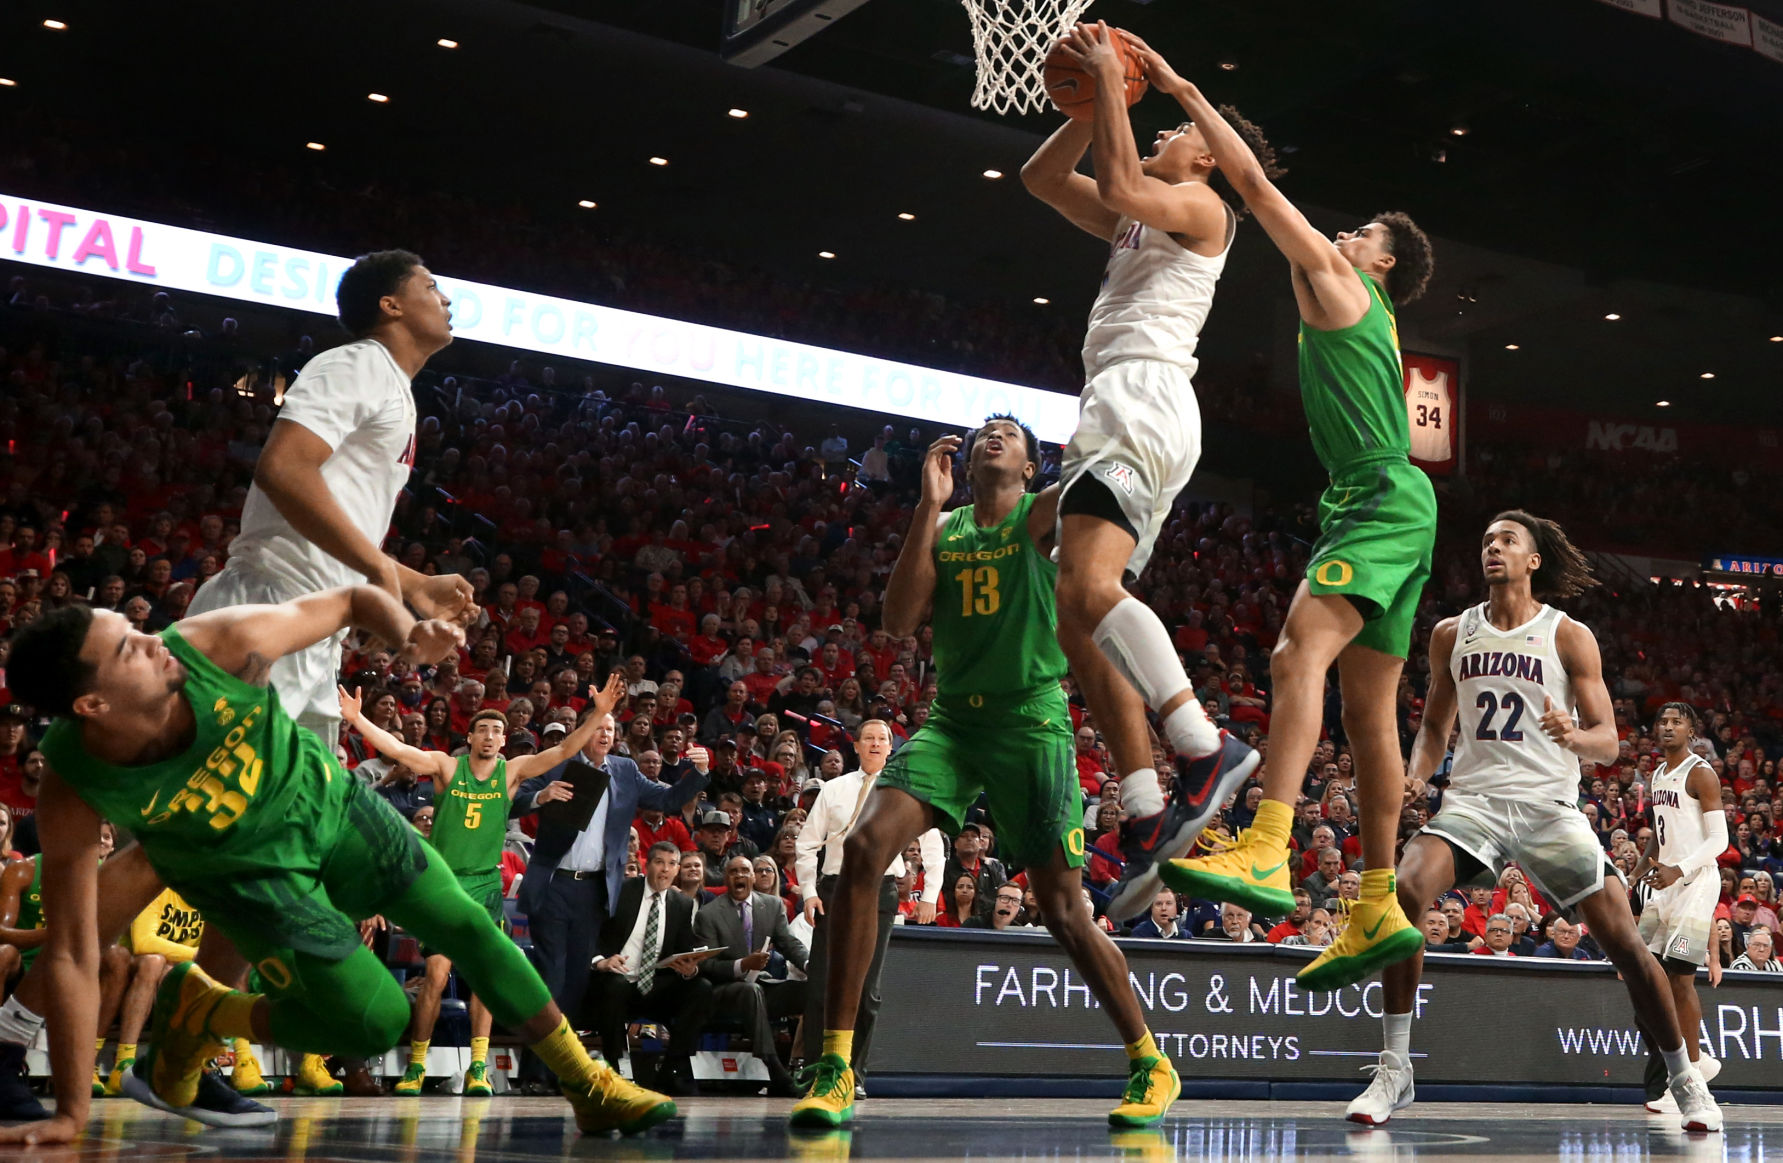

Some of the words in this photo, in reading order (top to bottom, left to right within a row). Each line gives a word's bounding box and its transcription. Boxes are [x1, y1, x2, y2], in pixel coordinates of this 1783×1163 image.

[501, 296, 598, 352] FOR
[734, 339, 844, 396] HERE
[861, 364, 942, 413] FOR
[1418, 390, 1438, 400] SIMON
[1416, 404, 1441, 429] 34
[1585, 420, 1679, 452] NCAA
[938, 543, 1020, 562] OREGON
[955, 566, 1000, 616] 13
[1459, 652, 1544, 686] ARIZONA
[1476, 691, 1524, 742] 22
[185, 742, 263, 829] 32
[451, 789, 502, 800] OREGON
[464, 802, 482, 829] 5
[1657, 814, 1665, 846] 3
[975, 965, 1188, 1012] FARHNG
[1205, 974, 1233, 1013] &
[1250, 976, 1434, 1019] MEDCOF
[1154, 1032, 1300, 1060] TTORNEYS
